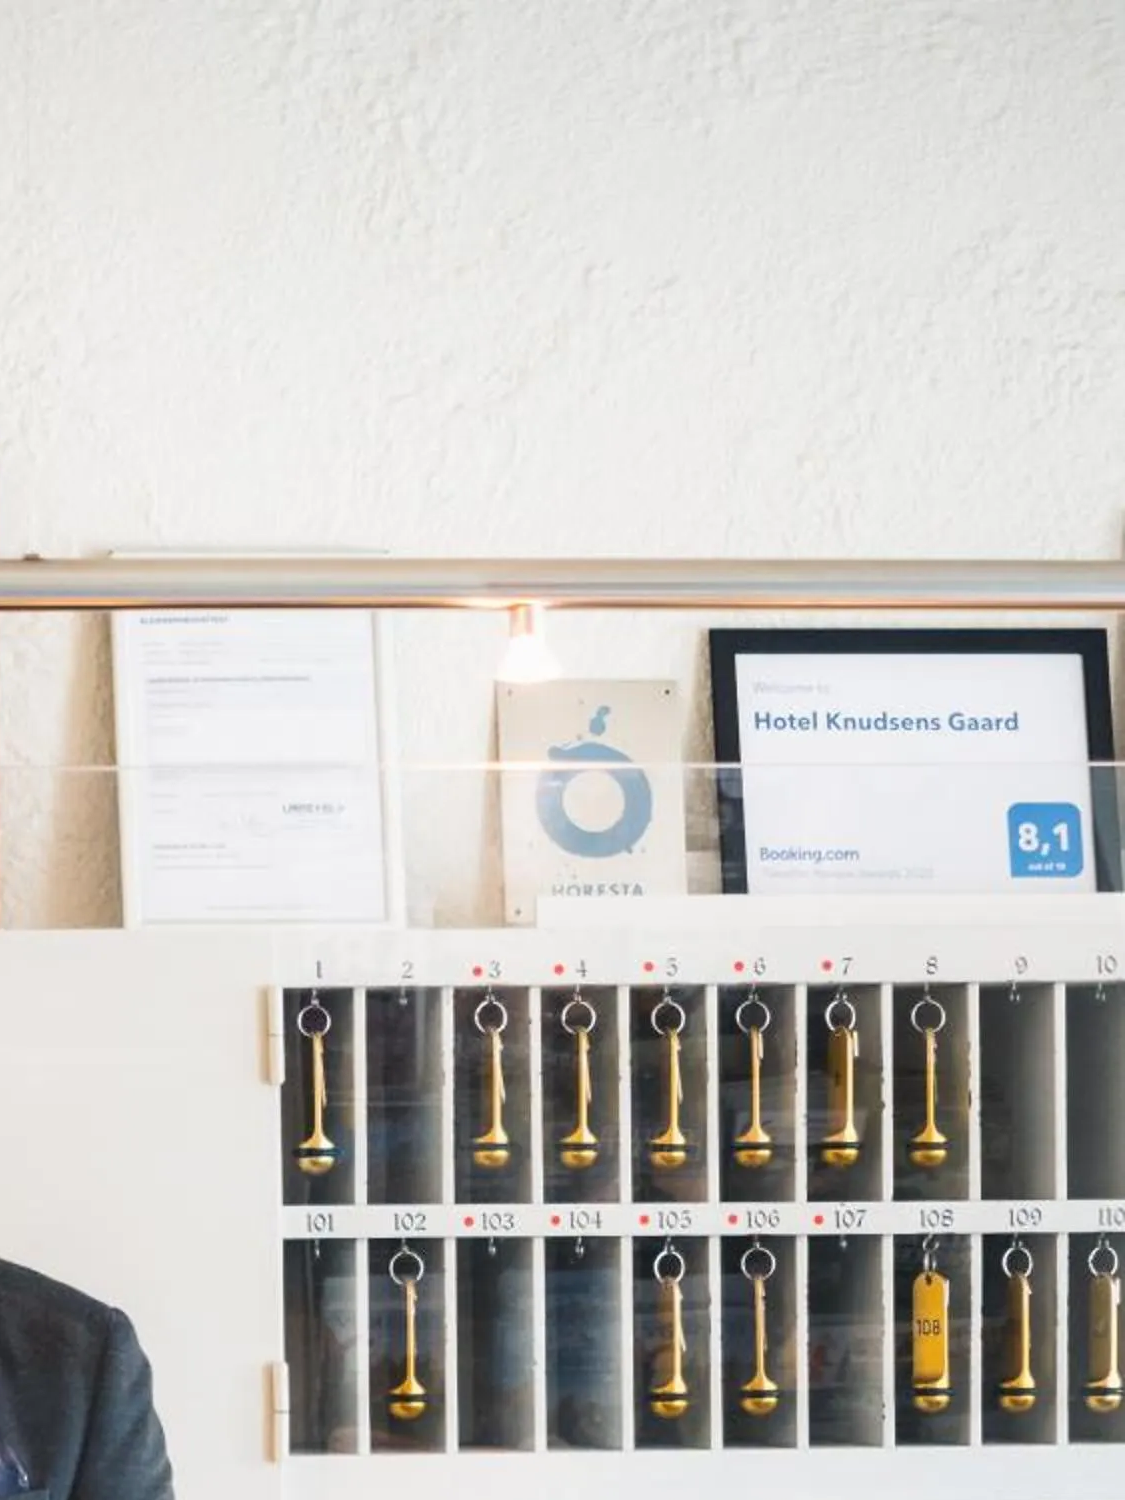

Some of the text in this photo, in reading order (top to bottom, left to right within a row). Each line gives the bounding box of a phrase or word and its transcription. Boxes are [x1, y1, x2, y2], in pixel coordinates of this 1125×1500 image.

[754, 711, 1020, 731] Hotel Knudsens Gaard
[1018, 822, 1070, 856] 8,1
[759, 846, 860, 863] Booking.com
[552, 883, 643, 897] HORESTA
[315, 955, 1118, 979] 1 2 3 4 5 6 7 8 9 10
[305, 1207, 1125, 1232] 101 102 103 104 105 106 107 108 109 110
[916, 1319, 941, 1336] 108
